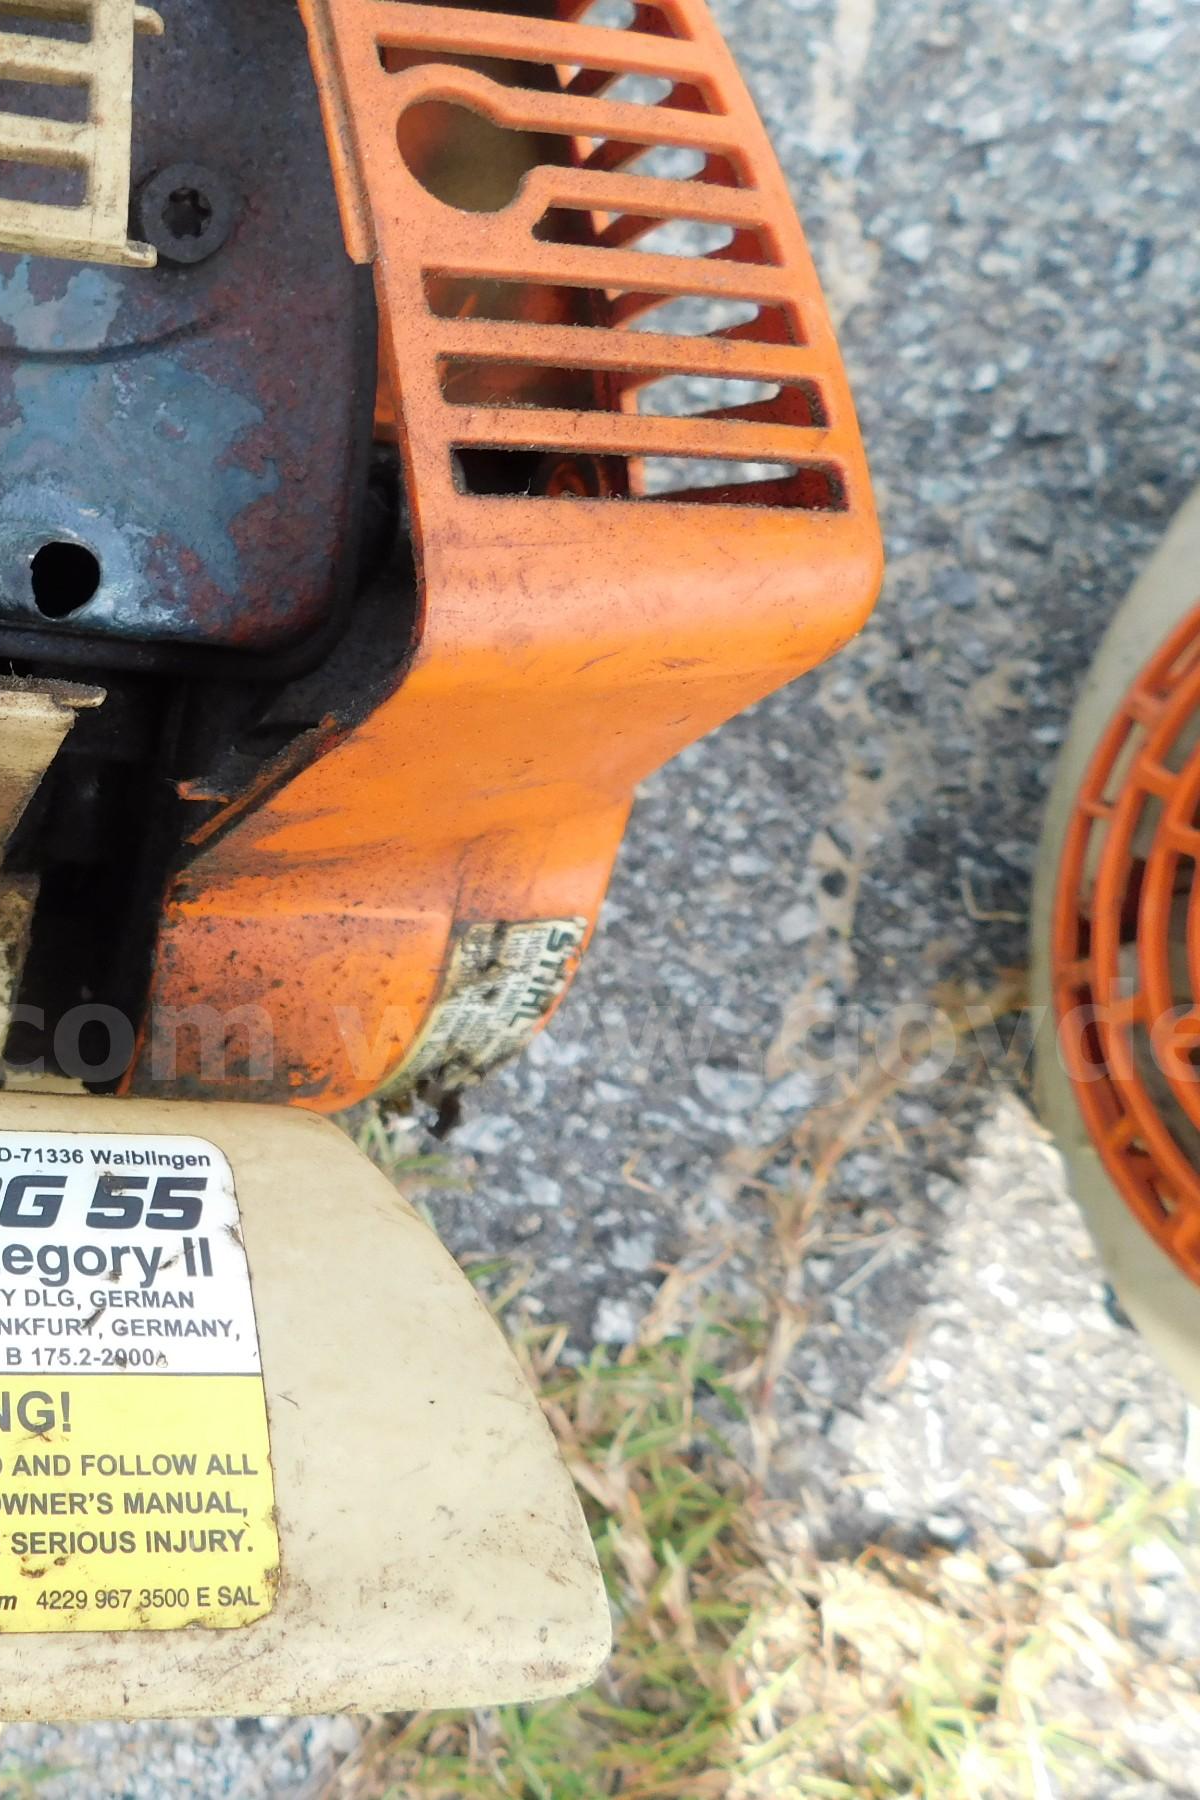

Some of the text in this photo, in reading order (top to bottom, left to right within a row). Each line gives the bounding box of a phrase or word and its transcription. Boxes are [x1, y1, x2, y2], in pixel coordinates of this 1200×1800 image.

[91, 1148, 212, 1171] Waiblingen
[85, 1175, 207, 1230] 55
[183, 1237, 215, 1278] II
[23, 1289, 82, 1311] DLG,
[88, 1290, 196, 1309] GERMAN
[111, 1319, 242, 1340] GERMANY,
[5, 1348, 23, 1367] B
[11, 1455, 74, 1478] AND
[80, 1453, 199, 1477] FOLLOW
[204, 1453, 259, 1476] ALL
[123, 1491, 249, 1518] MANUAL,
[11, 1531, 136, 1556] SERIOUS
[145, 1529, 254, 1553] INJURY.
[35, 1585, 261, 1610] 4229 967 3500 E SAL
